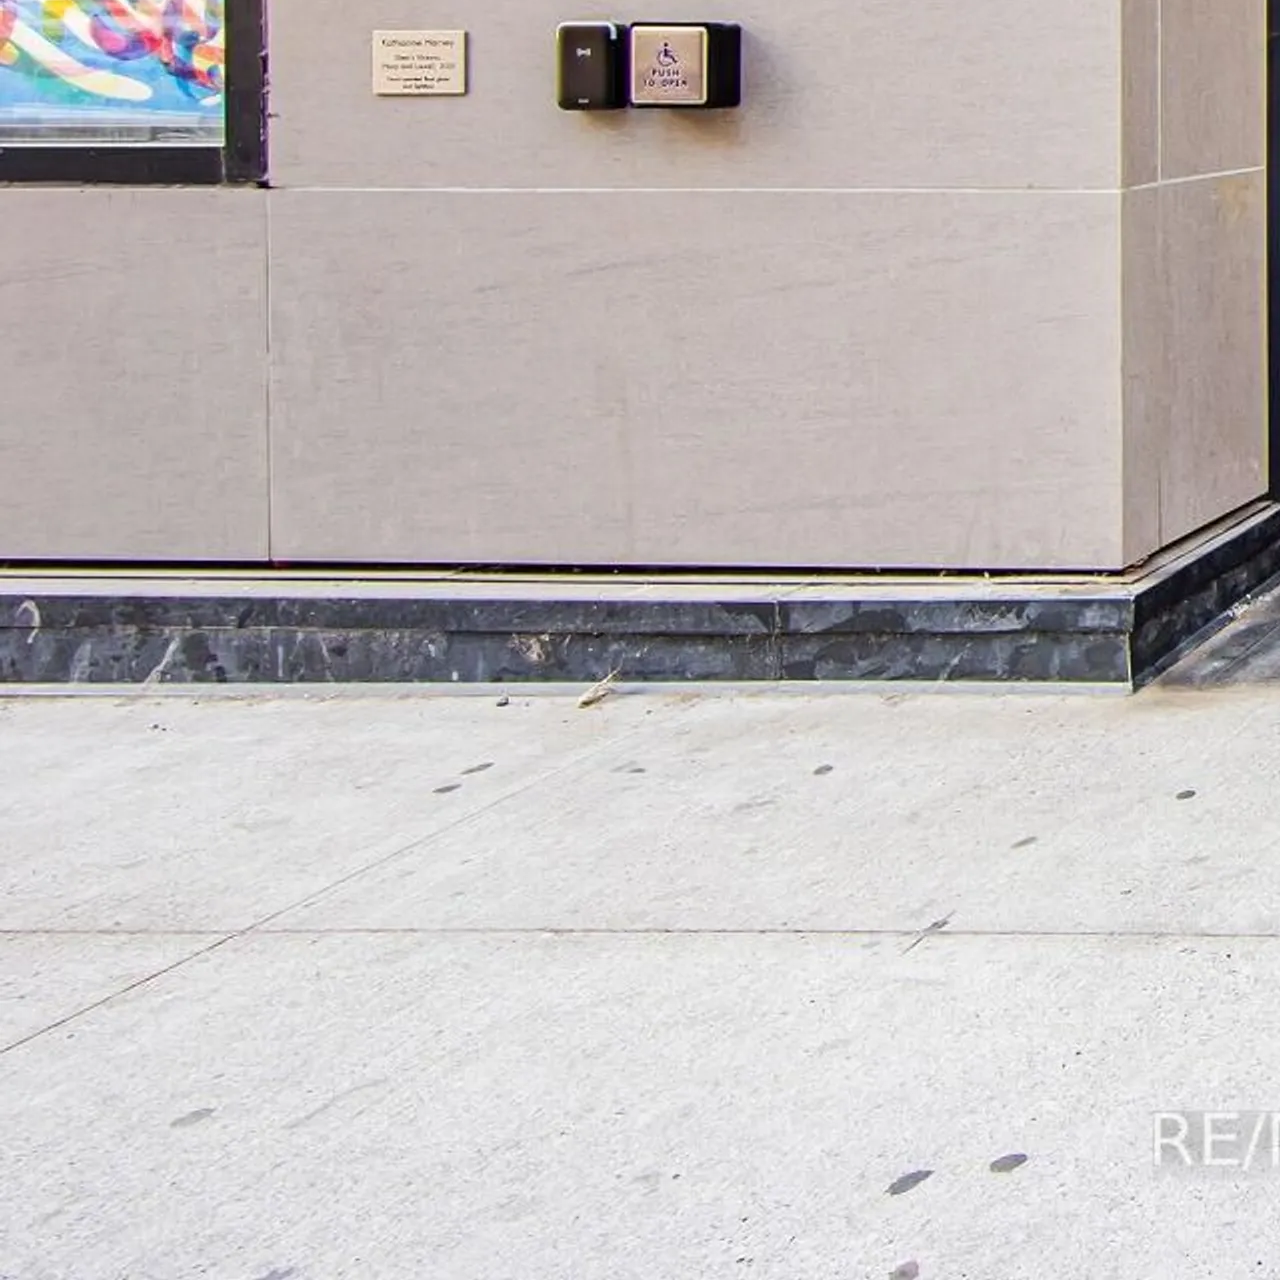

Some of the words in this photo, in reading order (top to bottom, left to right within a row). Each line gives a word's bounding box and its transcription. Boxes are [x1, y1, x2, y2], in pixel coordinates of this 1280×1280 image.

[652, 68, 680, 77] PUSH
[643, 79, 655, 87] TO
[661, 79, 688, 87] OPEN
